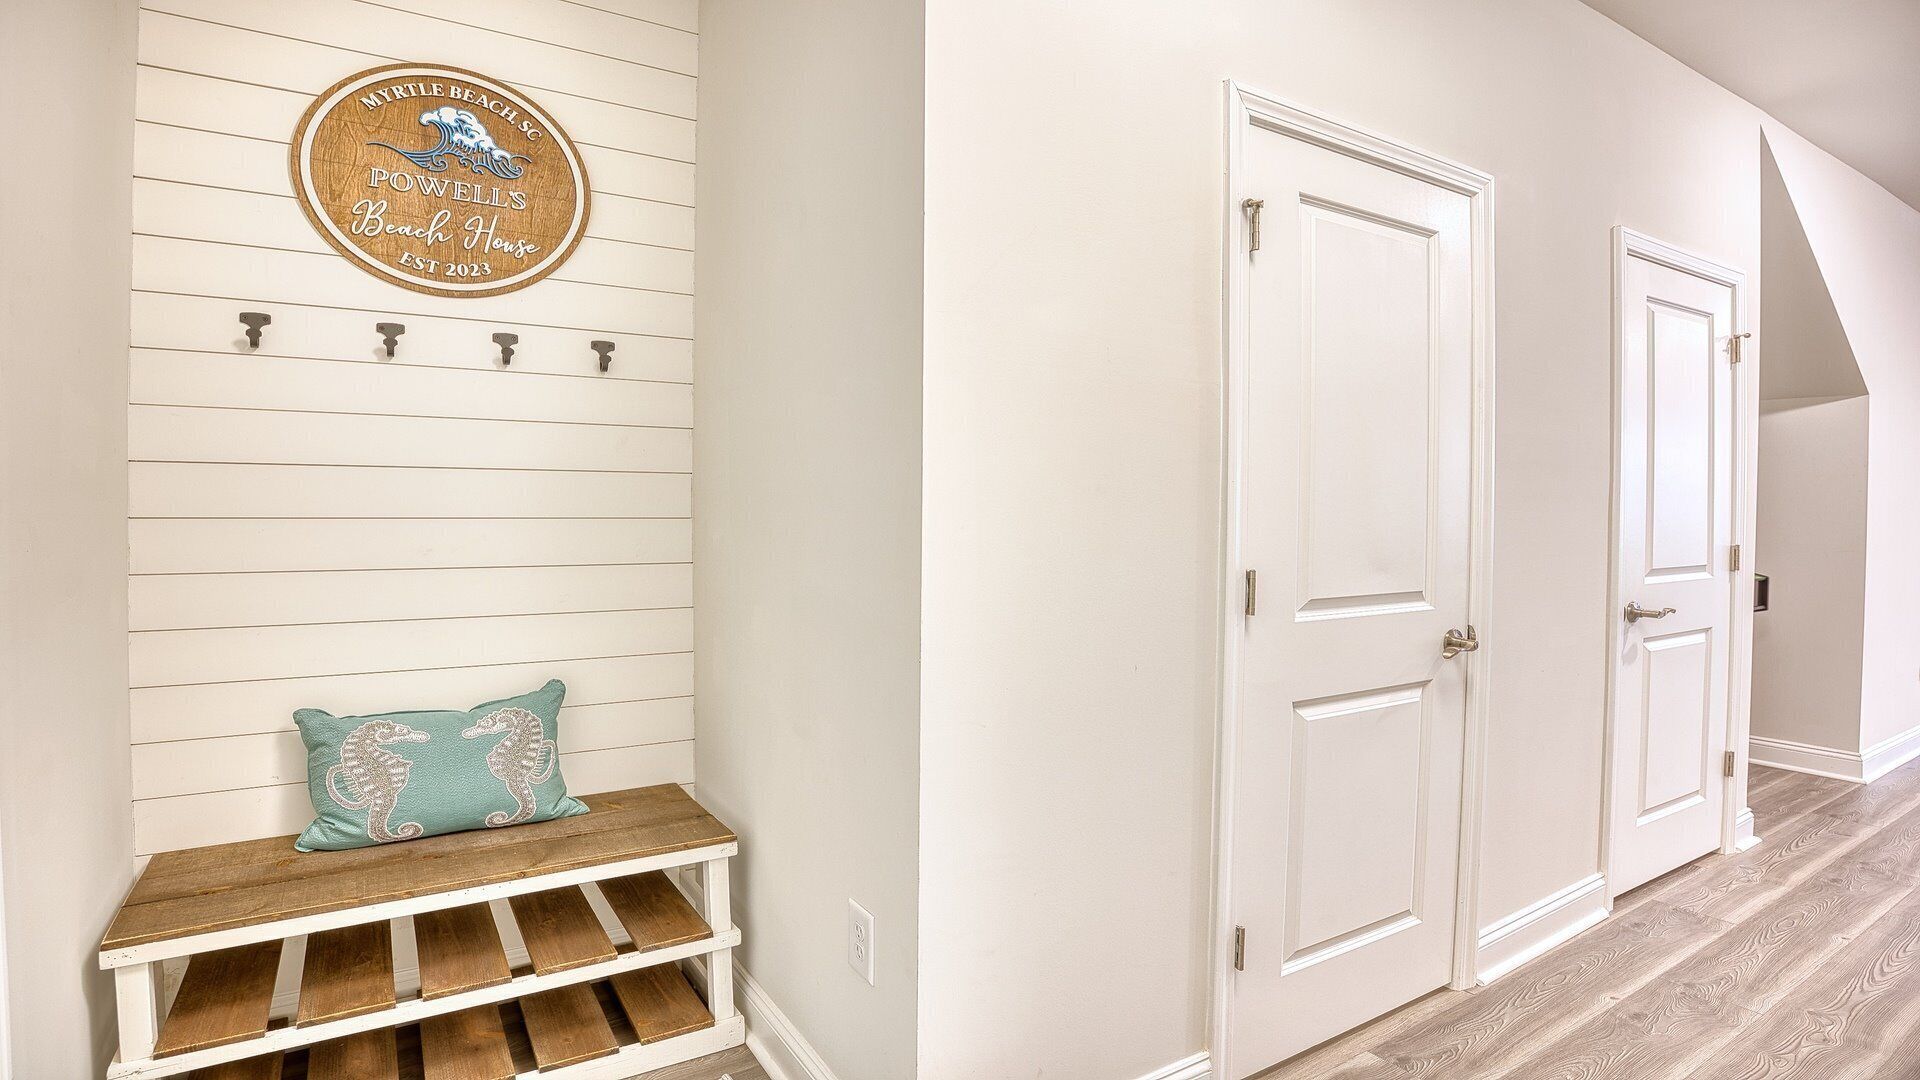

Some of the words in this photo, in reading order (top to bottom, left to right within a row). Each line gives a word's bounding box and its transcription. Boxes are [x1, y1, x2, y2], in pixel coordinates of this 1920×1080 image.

[359, 82, 445, 111] MYRTLE
[517, 119, 542, 142] SC
[368, 167, 527, 210] POWELL'S
[351, 199, 453, 247] Beach
[463, 214, 541, 259] House
[398, 251, 440, 274] EST
[445, 262, 492, 278] 2023
